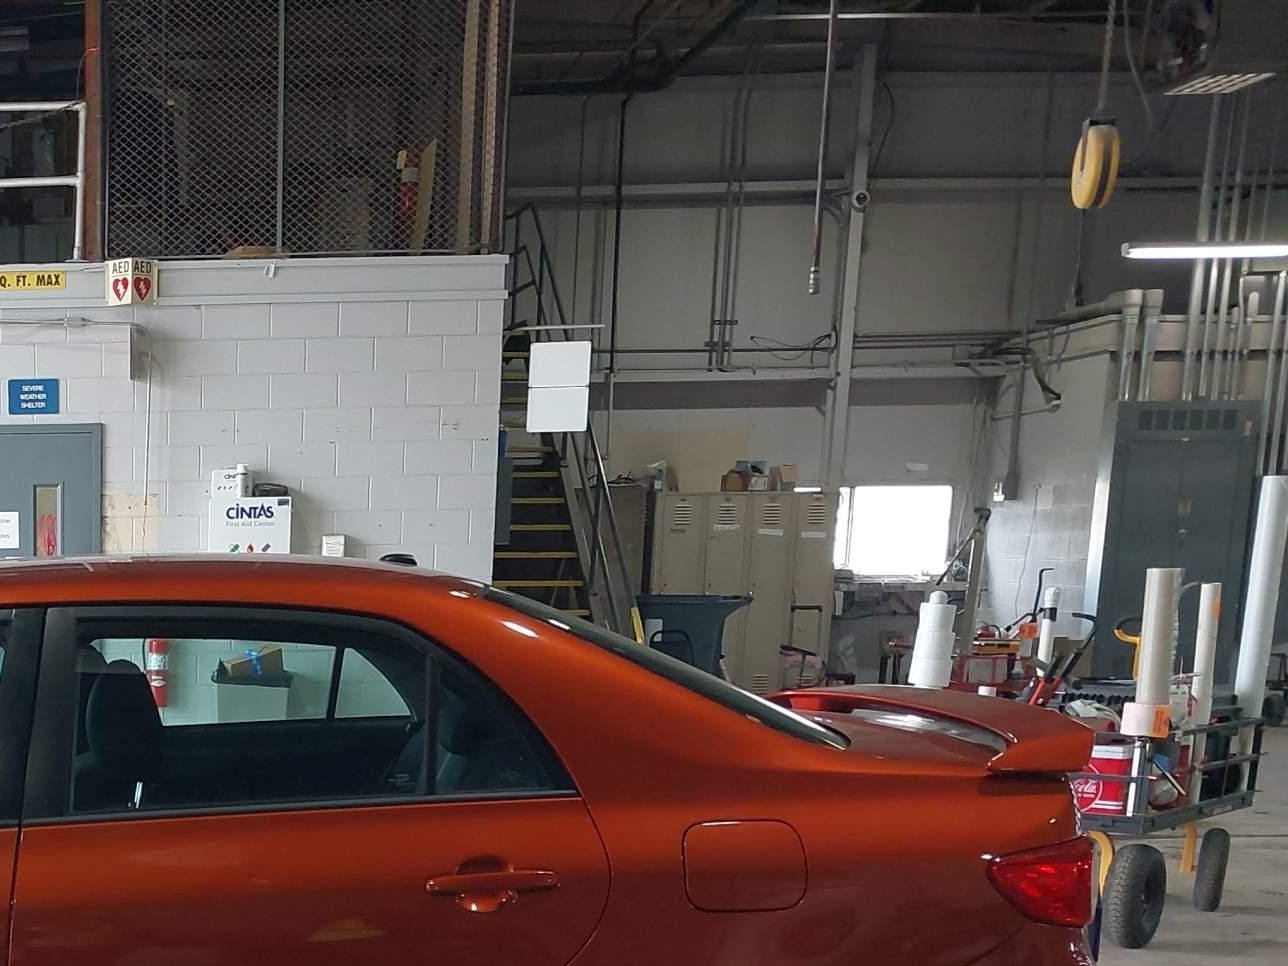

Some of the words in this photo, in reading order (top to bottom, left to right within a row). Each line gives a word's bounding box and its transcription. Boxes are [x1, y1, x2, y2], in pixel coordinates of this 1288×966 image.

[112, 260, 129, 274] AED
[133, 261, 152, 273] AED
[16, 274, 31, 287] FT.
[36, 274, 61, 287] MAX
[225, 502, 274, 519] CINTAS
